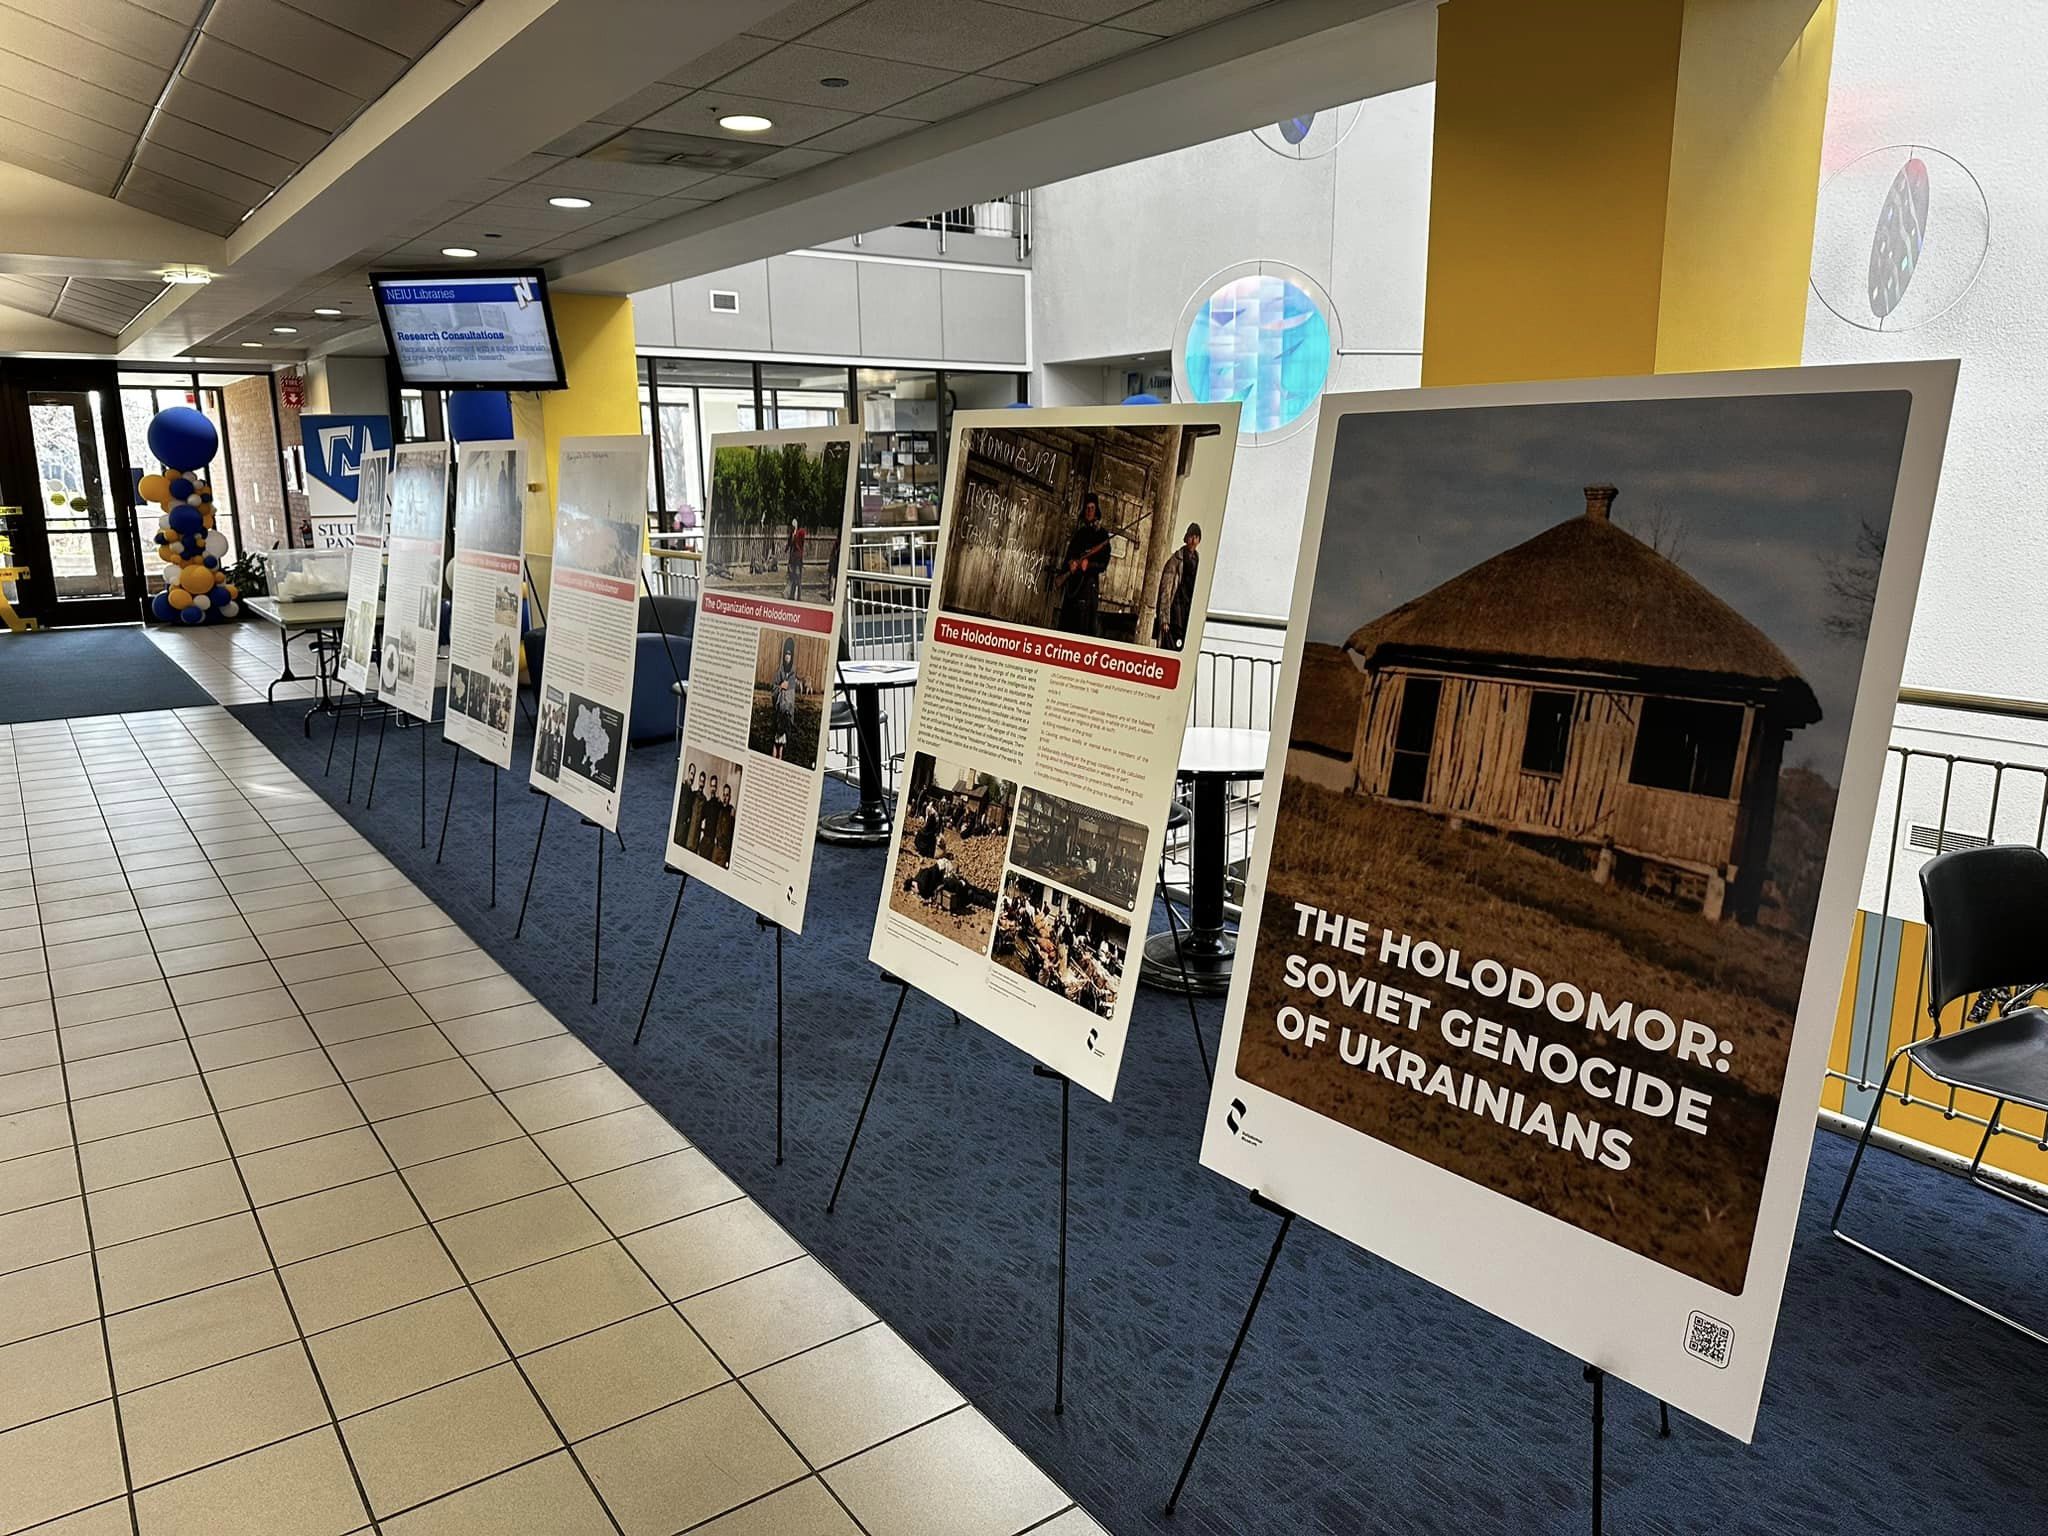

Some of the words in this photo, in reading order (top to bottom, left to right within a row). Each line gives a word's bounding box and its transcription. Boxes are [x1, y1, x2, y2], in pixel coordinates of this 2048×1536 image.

[413, 289, 455, 300] Libraries
[397, 331, 440, 340] Research
[442, 330, 504, 340] Consultations
[704, 598, 716, 609] The
[716, 600, 754, 616] Organization
[755, 605, 763, 616] of
[763, 606, 801, 623] Holodomor
[941, 624, 959, 639] The
[961, 630, 1021, 652] Holodomor
[1023, 638, 1032, 654] is
[1034, 644, 1041, 656] a
[1045, 644, 1080, 663] Crime
[1084, 654, 1098, 667] of
[1100, 654, 1164, 680] Genocide
[1292, 902, 1372, 956] THE
[1378, 928, 1736, 1073] HOLODOMOR:
[1283, 954, 1430, 1031] SOVIET
[1440, 1009, 1714, 1136] GENOCIDE
[1276, 1005, 1328, 1048] OF
[1339, 1027, 1634, 1172] UKRAINIANS
